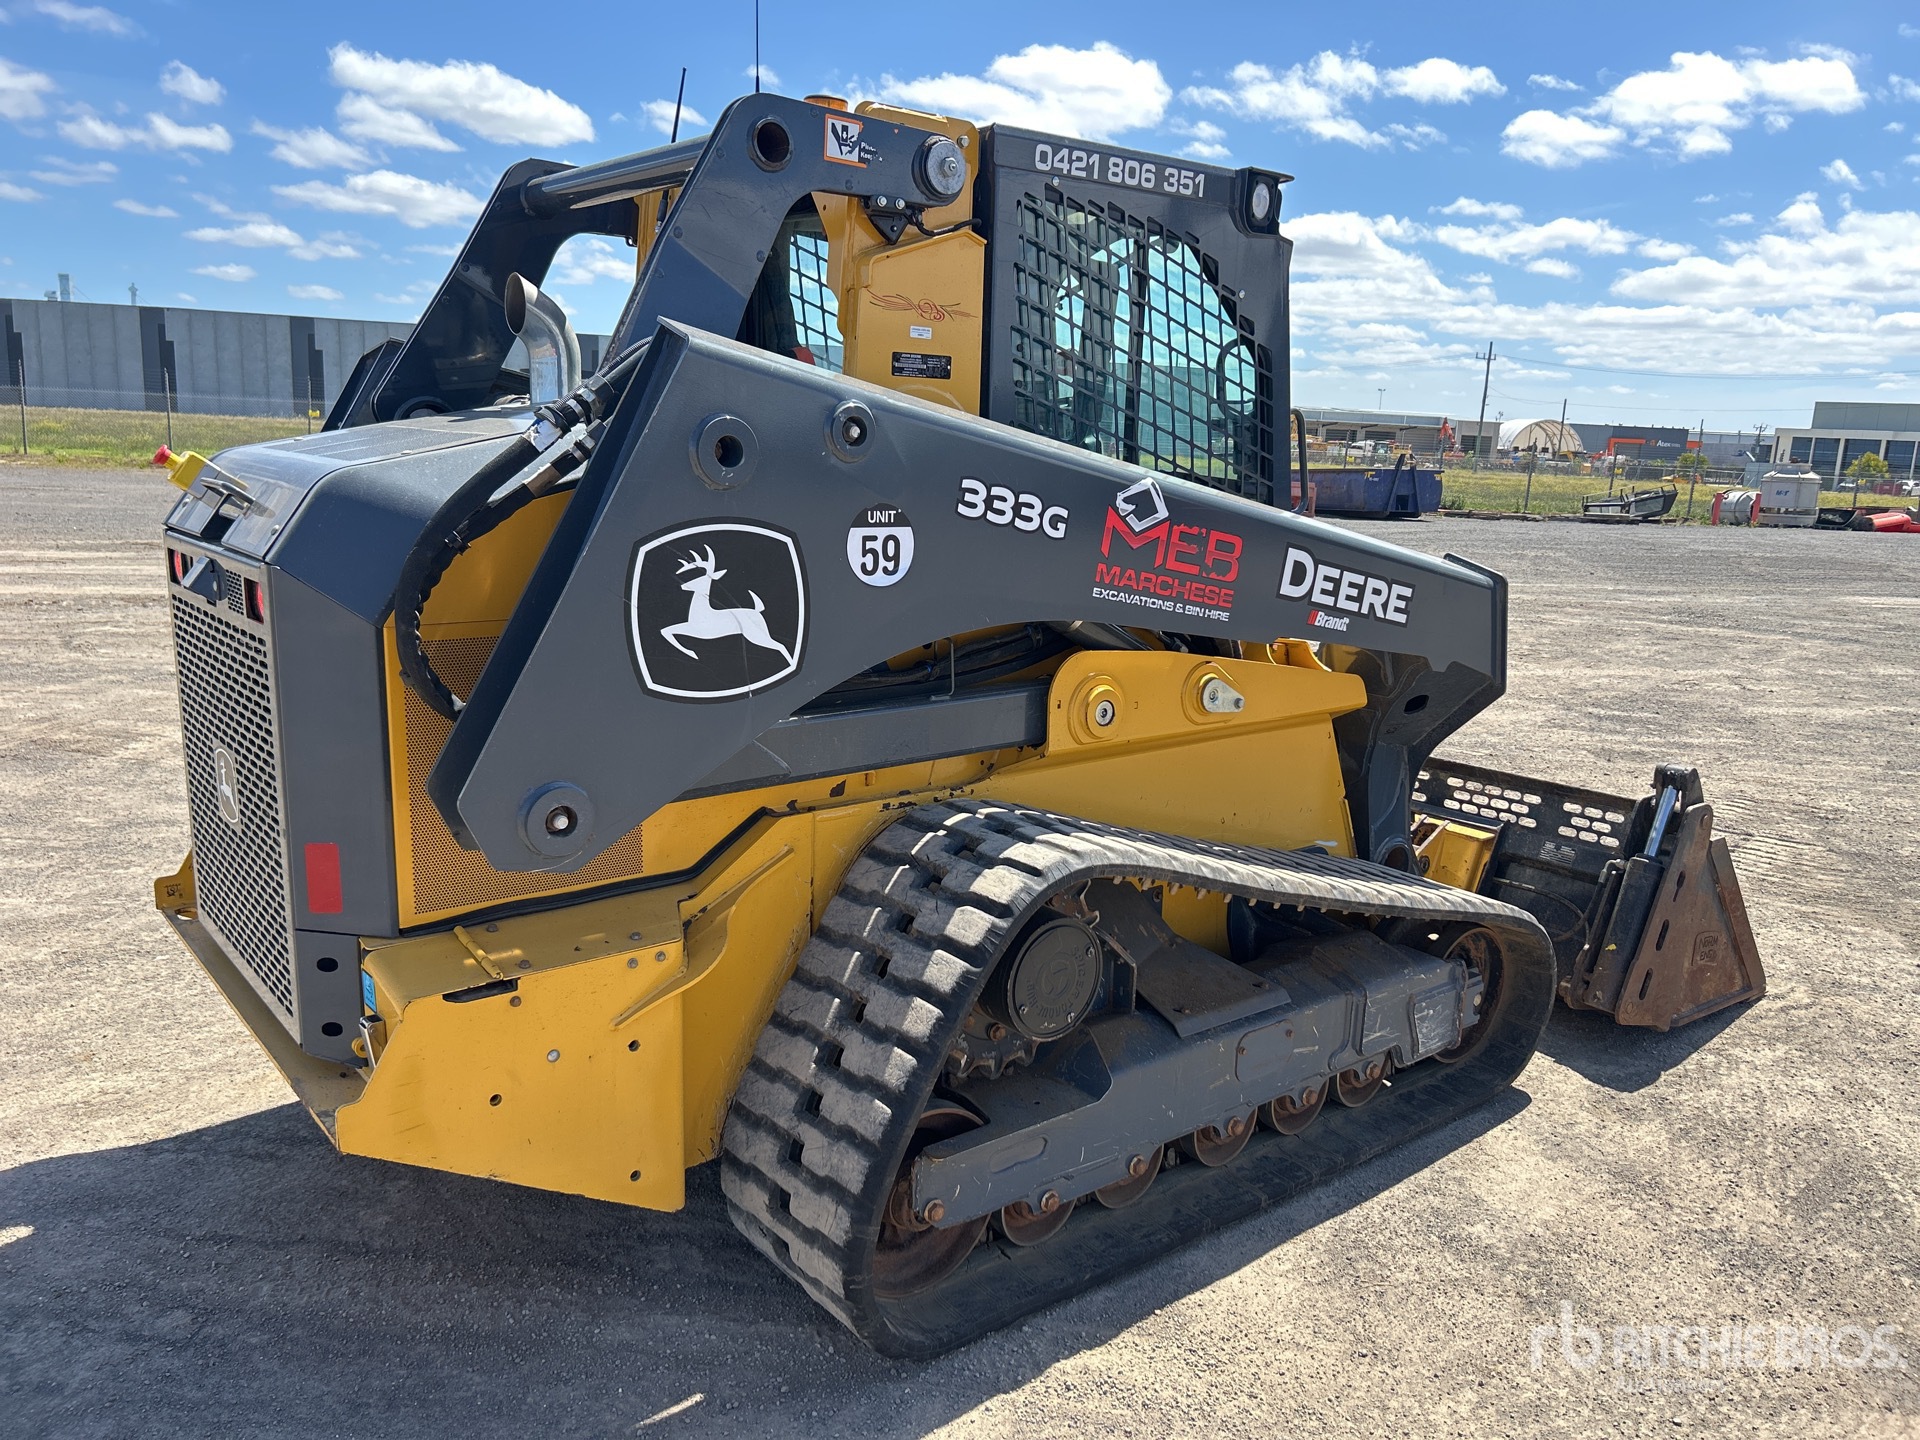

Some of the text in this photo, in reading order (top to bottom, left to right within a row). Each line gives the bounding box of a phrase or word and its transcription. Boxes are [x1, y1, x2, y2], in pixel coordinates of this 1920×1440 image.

[1035, 143, 1205, 197] 0421 806 351
[867, 510, 897, 523] UNIT
[957, 478, 1069, 539] 333G
[860, 534, 901, 576] 59
[1092, 587, 1230, 622] EXCAVATIONS & BIN HIRE
[1095, 562, 1235, 608] MARCHESE
[1279, 547, 1413, 624] DEERE
[1314, 610, 1350, 632] Brandt
